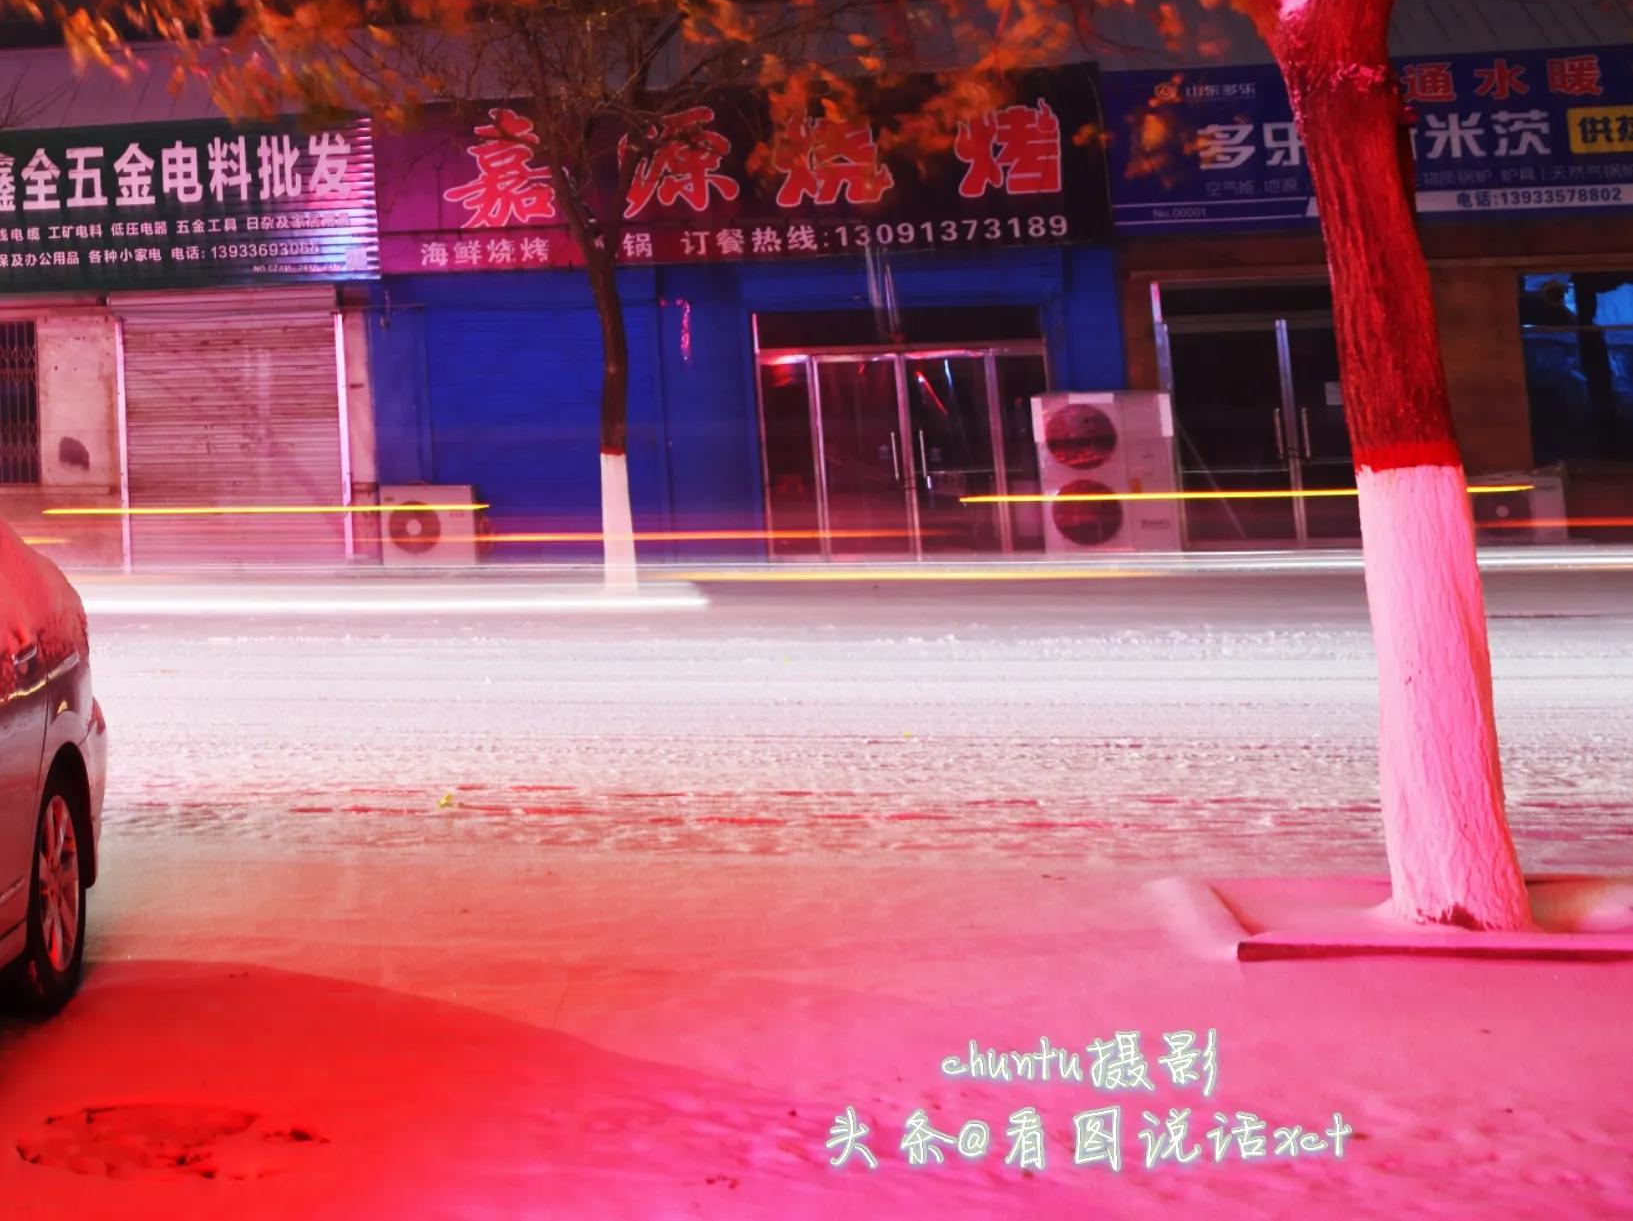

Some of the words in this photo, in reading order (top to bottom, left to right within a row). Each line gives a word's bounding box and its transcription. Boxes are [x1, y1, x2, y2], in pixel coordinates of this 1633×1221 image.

[1185, 82, 1256, 98] 山东多乐
[1409, 108, 1552, 160] 米茨
[48, 223, 103, 239] 工矿电料
[111, 220, 168, 236] 低压电器
[176, 218, 238, 234] 五金工具
[88, 248, 162, 264] 各种小家电
[420, 236, 550, 267] 海鲜烧烤
